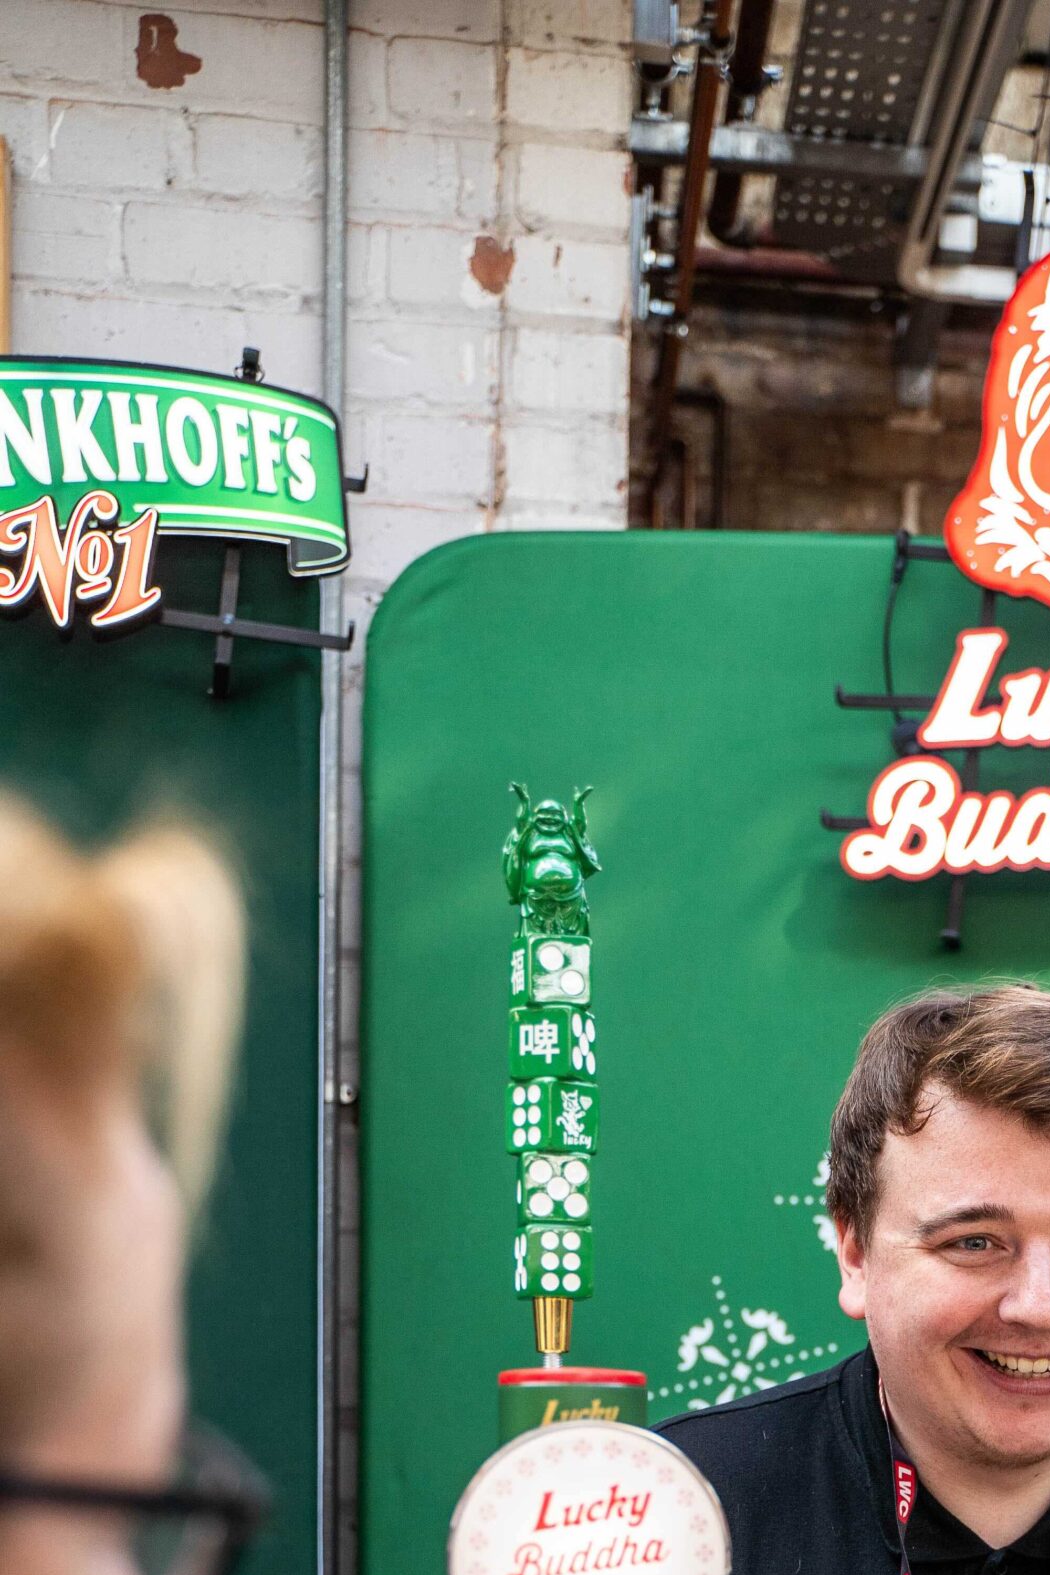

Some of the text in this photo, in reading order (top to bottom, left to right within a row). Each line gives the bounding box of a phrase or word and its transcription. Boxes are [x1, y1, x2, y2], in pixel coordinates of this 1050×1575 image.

[519, 1019, 560, 1064] 啤
[534, 1485, 651, 1531] Lucky
[896, 1466, 913, 1519] LWC
